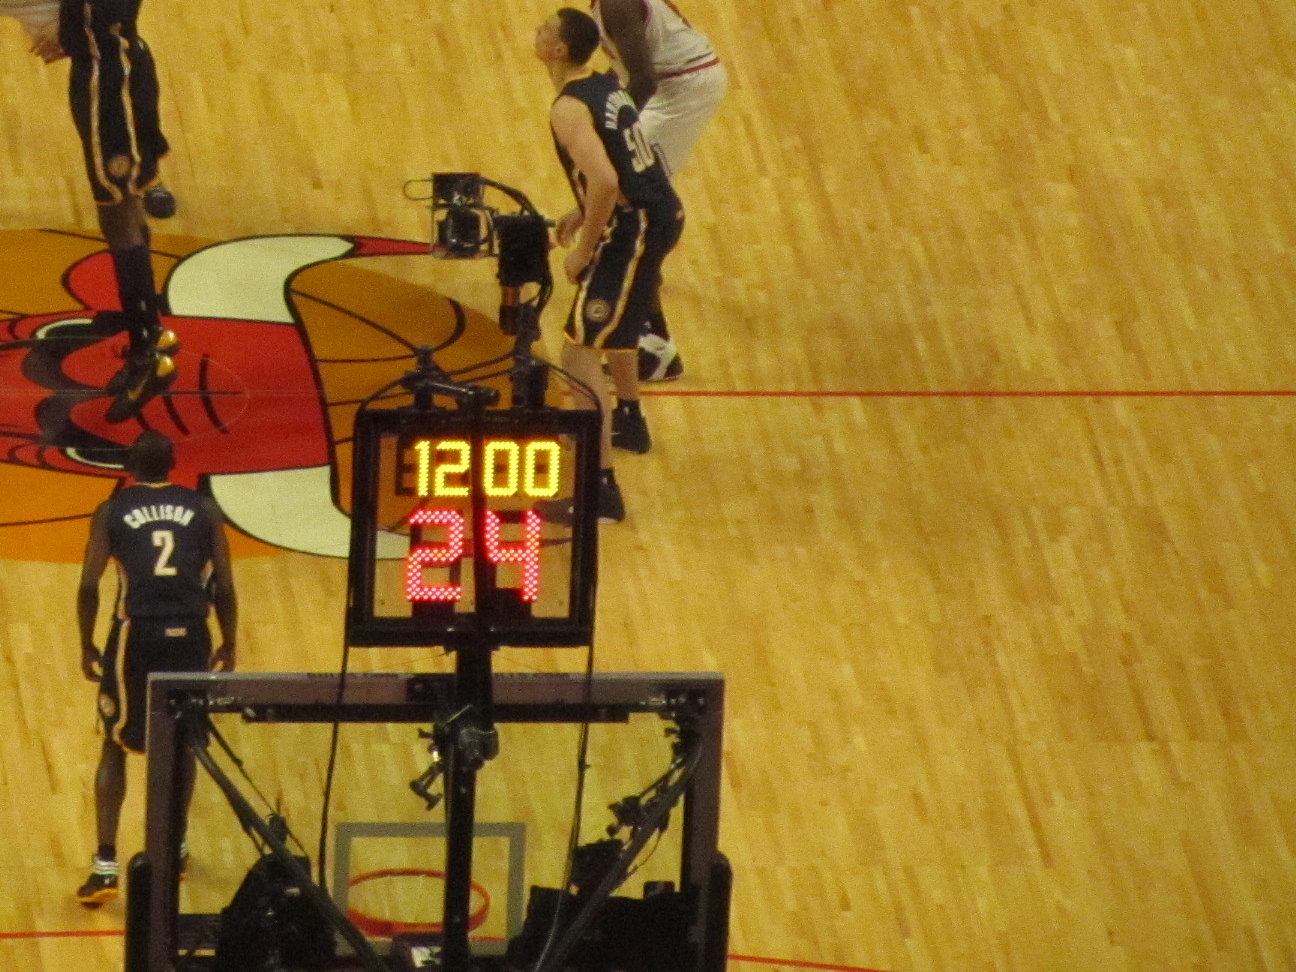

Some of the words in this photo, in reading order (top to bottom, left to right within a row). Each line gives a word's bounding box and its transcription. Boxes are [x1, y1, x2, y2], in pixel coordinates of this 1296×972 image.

[123, 504, 195, 529] COLLISON
[152, 530, 178, 576] 2
[405, 509, 541, 602] 24
